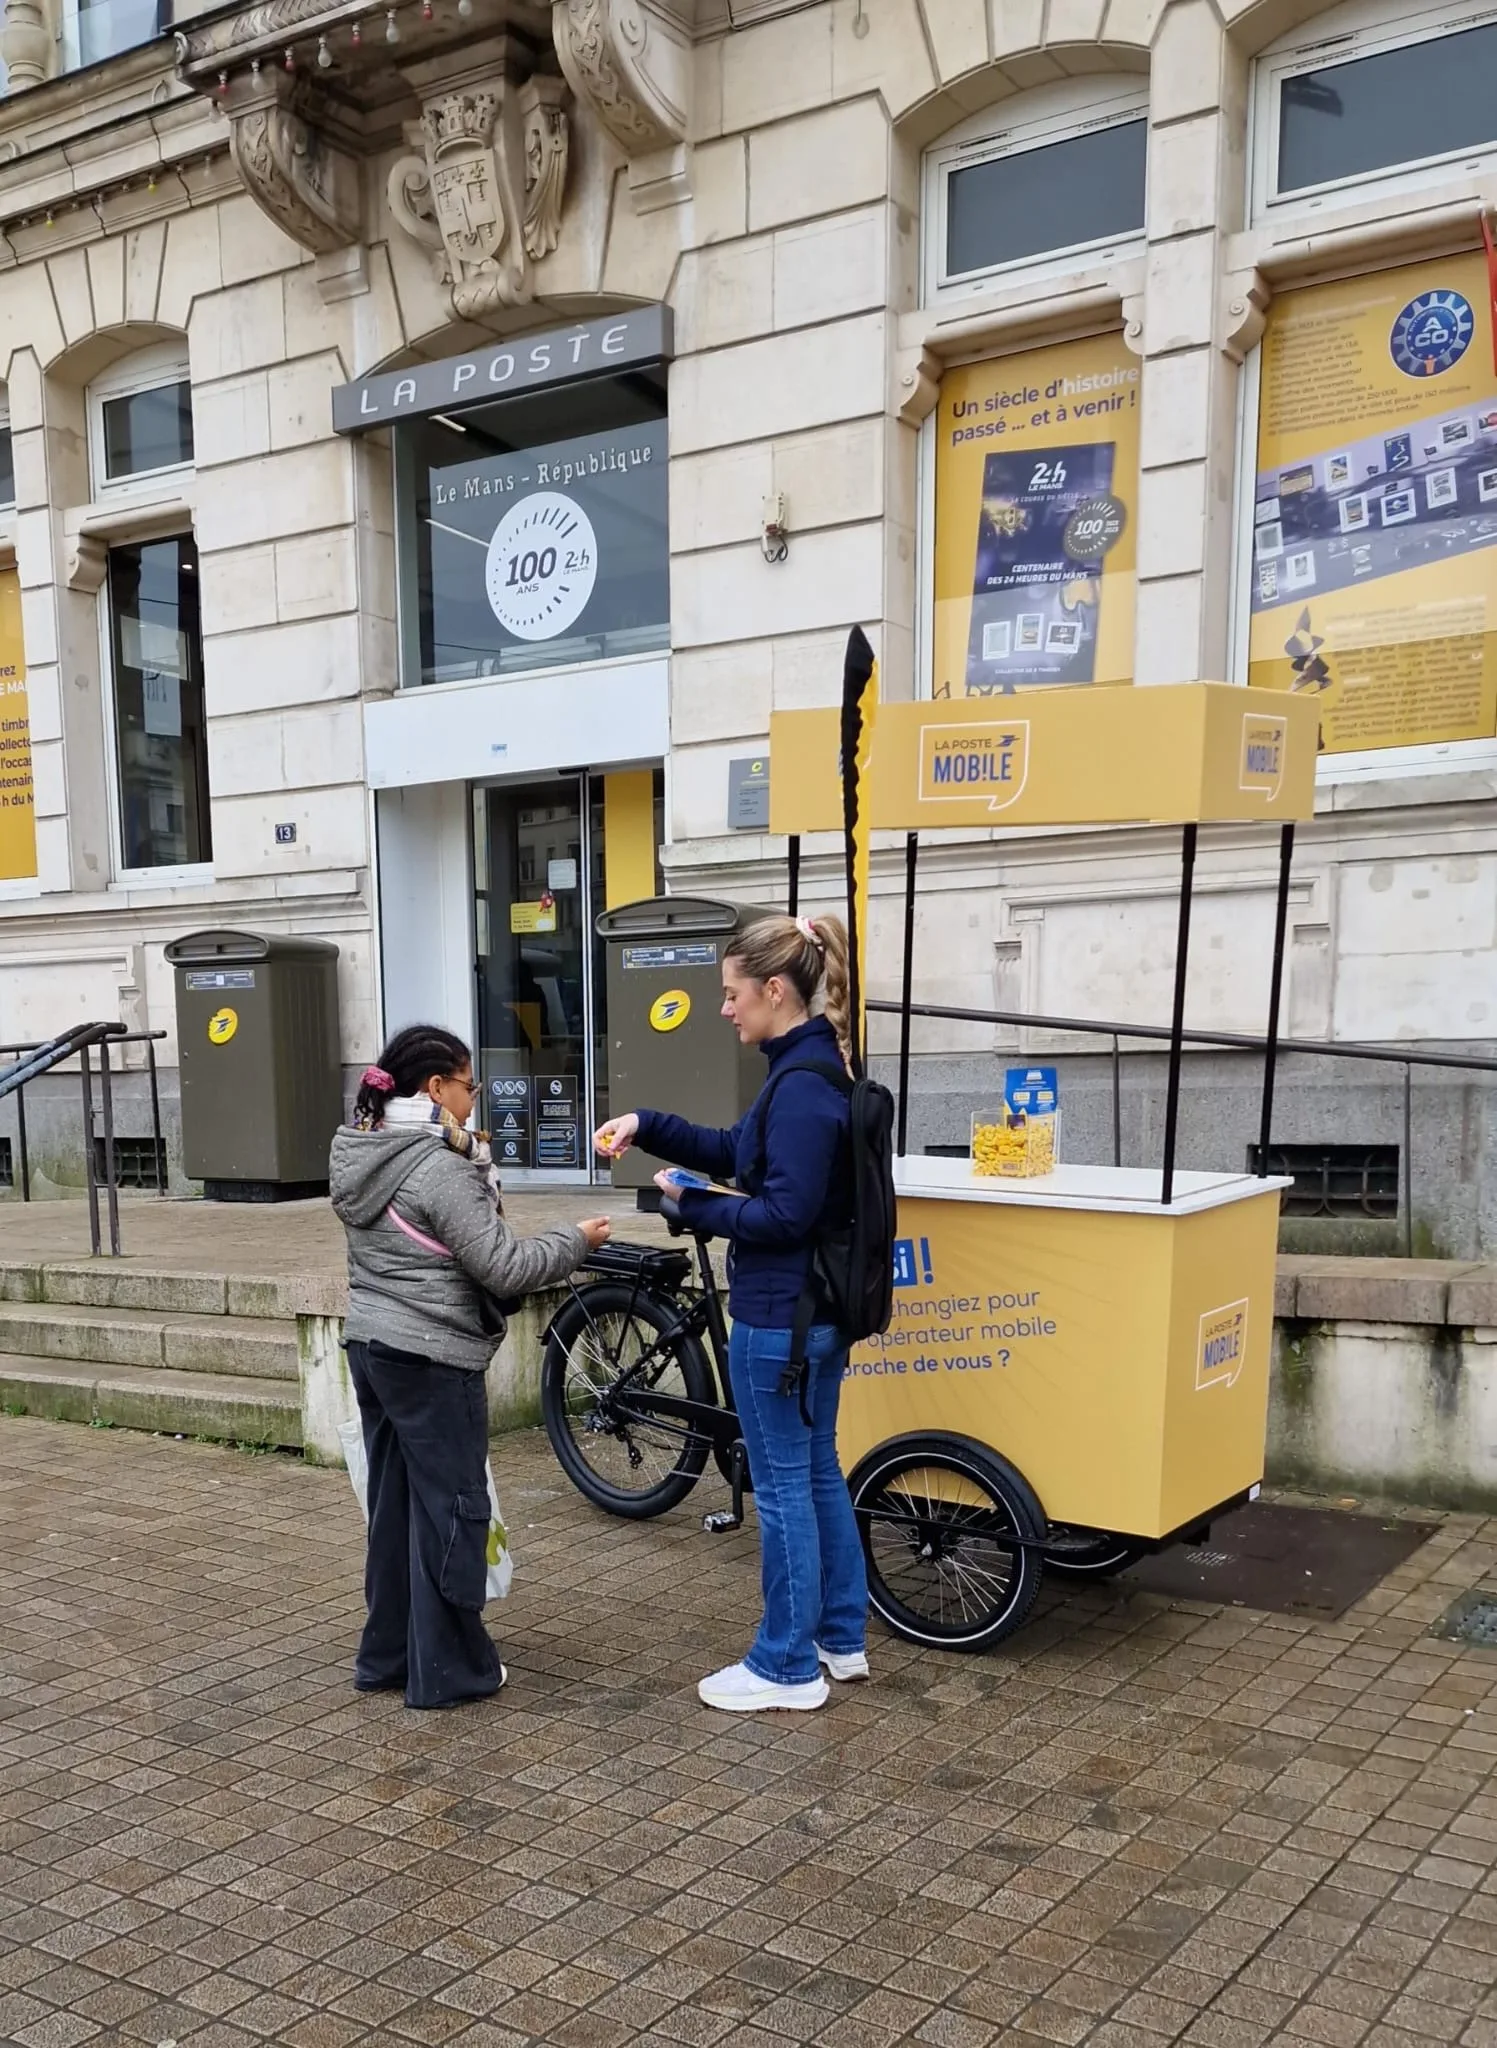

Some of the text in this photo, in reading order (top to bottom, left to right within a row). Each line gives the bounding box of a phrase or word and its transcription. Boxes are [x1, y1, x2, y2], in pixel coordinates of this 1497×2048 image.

[360, 324, 628, 415] LA POSTE
[953, 401, 978, 418] Un
[984, 387, 1039, 412] siècle
[952, 417, 1006, 446] passé
[1031, 410, 1051, 427] et
[1056, 404, 1068, 422] à
[1073, 394, 1125, 418] venir
[1129, 390, 1136, 407] !
[436, 484, 457, 505] Le
[464, 475, 515, 498] Mans
[537, 446, 652, 485] République
[1074, 519, 1103, 536] 100
[505, 547, 557, 587] 100
[987, 571, 1088, 585] DES 24 HEURES DU MANS
[1012, 562, 1064, 573] CENTENAIRE
[516, 583, 540, 596] ANS
[934, 738, 992, 750] LA POSTE
[11, 793, 25, 806] du
[279, 826, 291, 840] 13
[920, 1236, 934, 1284] !
[892, 1291, 1040, 1320] hangiez pour
[981, 1316, 1056, 1339] mobile
[913, 1354, 938, 1373] de
[943, 1354, 992, 1371] vous
[997, 1348, 1010, 1367] ?
